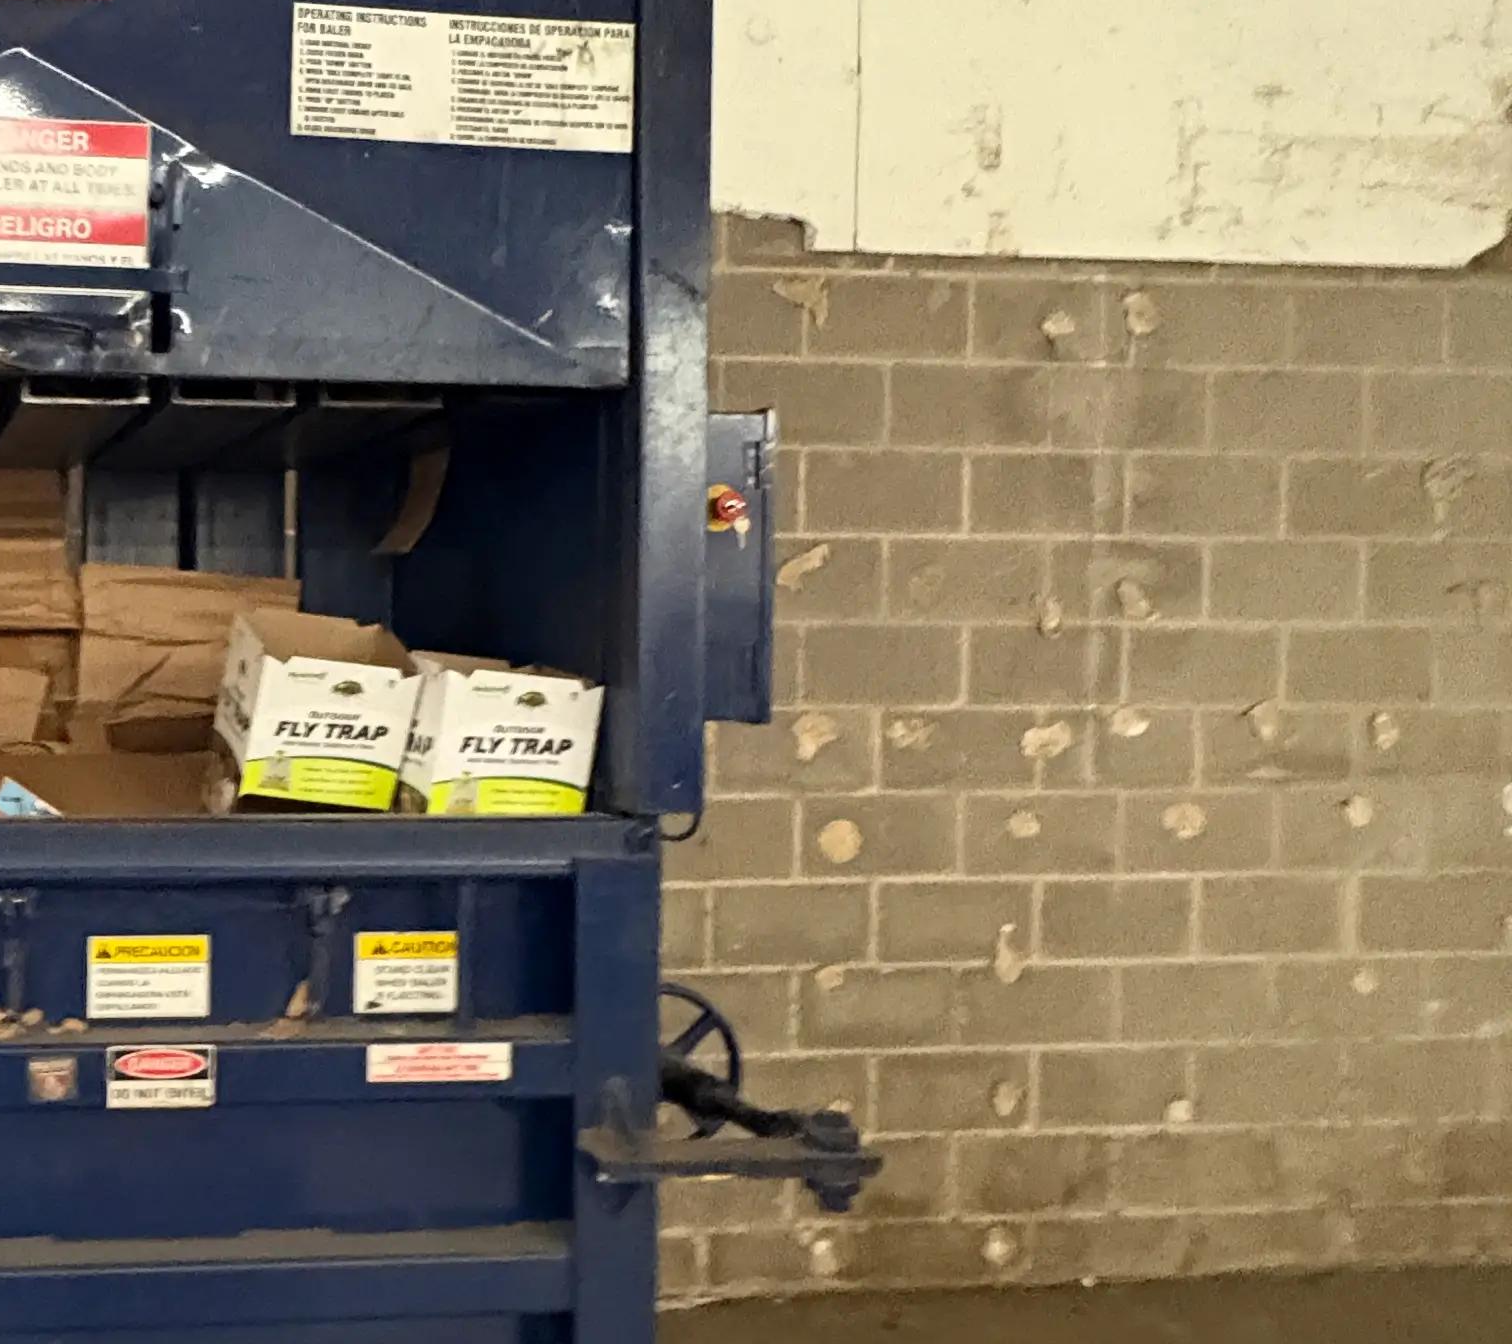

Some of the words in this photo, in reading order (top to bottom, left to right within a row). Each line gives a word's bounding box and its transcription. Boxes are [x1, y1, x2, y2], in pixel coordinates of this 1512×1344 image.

[297, 7, 353, 22] OPERATING
[356, 12, 427, 28] INSTRUCTIONS
[529, 23, 541, 35] DE
[29, 179, 48, 193] AT
[53, 181, 81, 194] ALL
[273, 720, 319, 738] FLY
[324, 723, 390, 741] TRAP
[459, 736, 506, 754] FLY
[511, 737, 575, 755] TRAP
